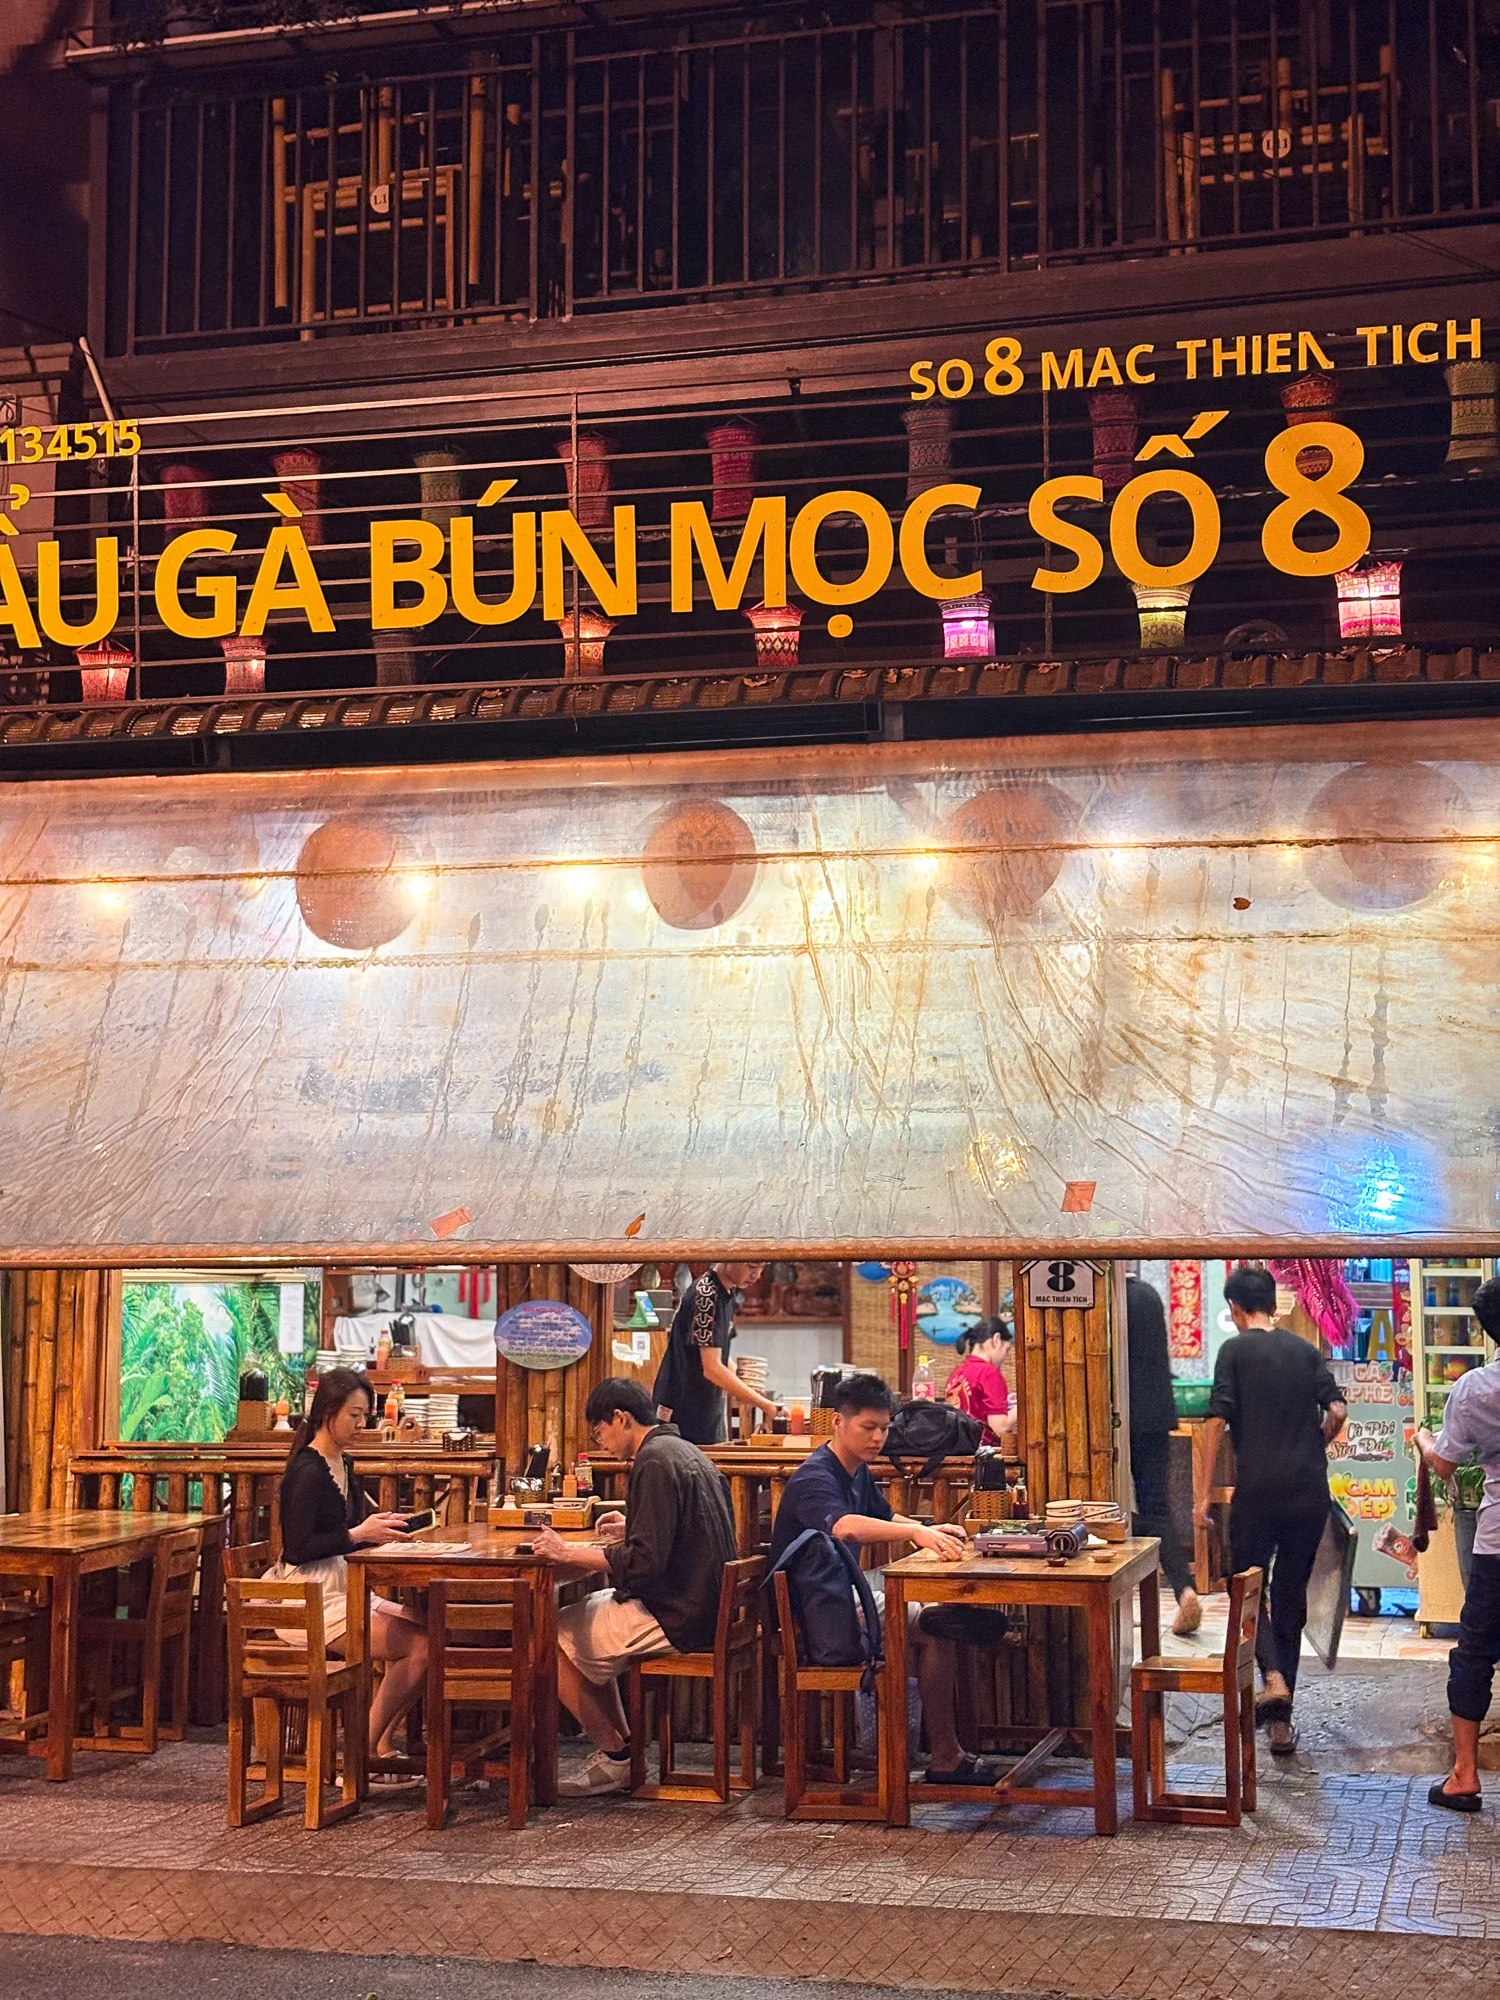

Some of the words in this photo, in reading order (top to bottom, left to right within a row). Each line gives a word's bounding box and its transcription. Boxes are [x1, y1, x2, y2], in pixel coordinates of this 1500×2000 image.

[909, 358, 975, 401] SO
[983, 336, 1025, 396] 8
[1041, 343, 1156, 391] MAC
[1356, 318, 1482, 367] TICH
[154, 492, 337, 639] GÀ
[368, 479, 638, 630] BÚN
[670, 483, 983, 638] MỌC
[1028, 411, 1227, 594] SỐ
[1261, 422, 1371, 577] 8
[1047, 1262, 1075, 1292] 8
[1345, 1478, 1397, 1497] CAM
